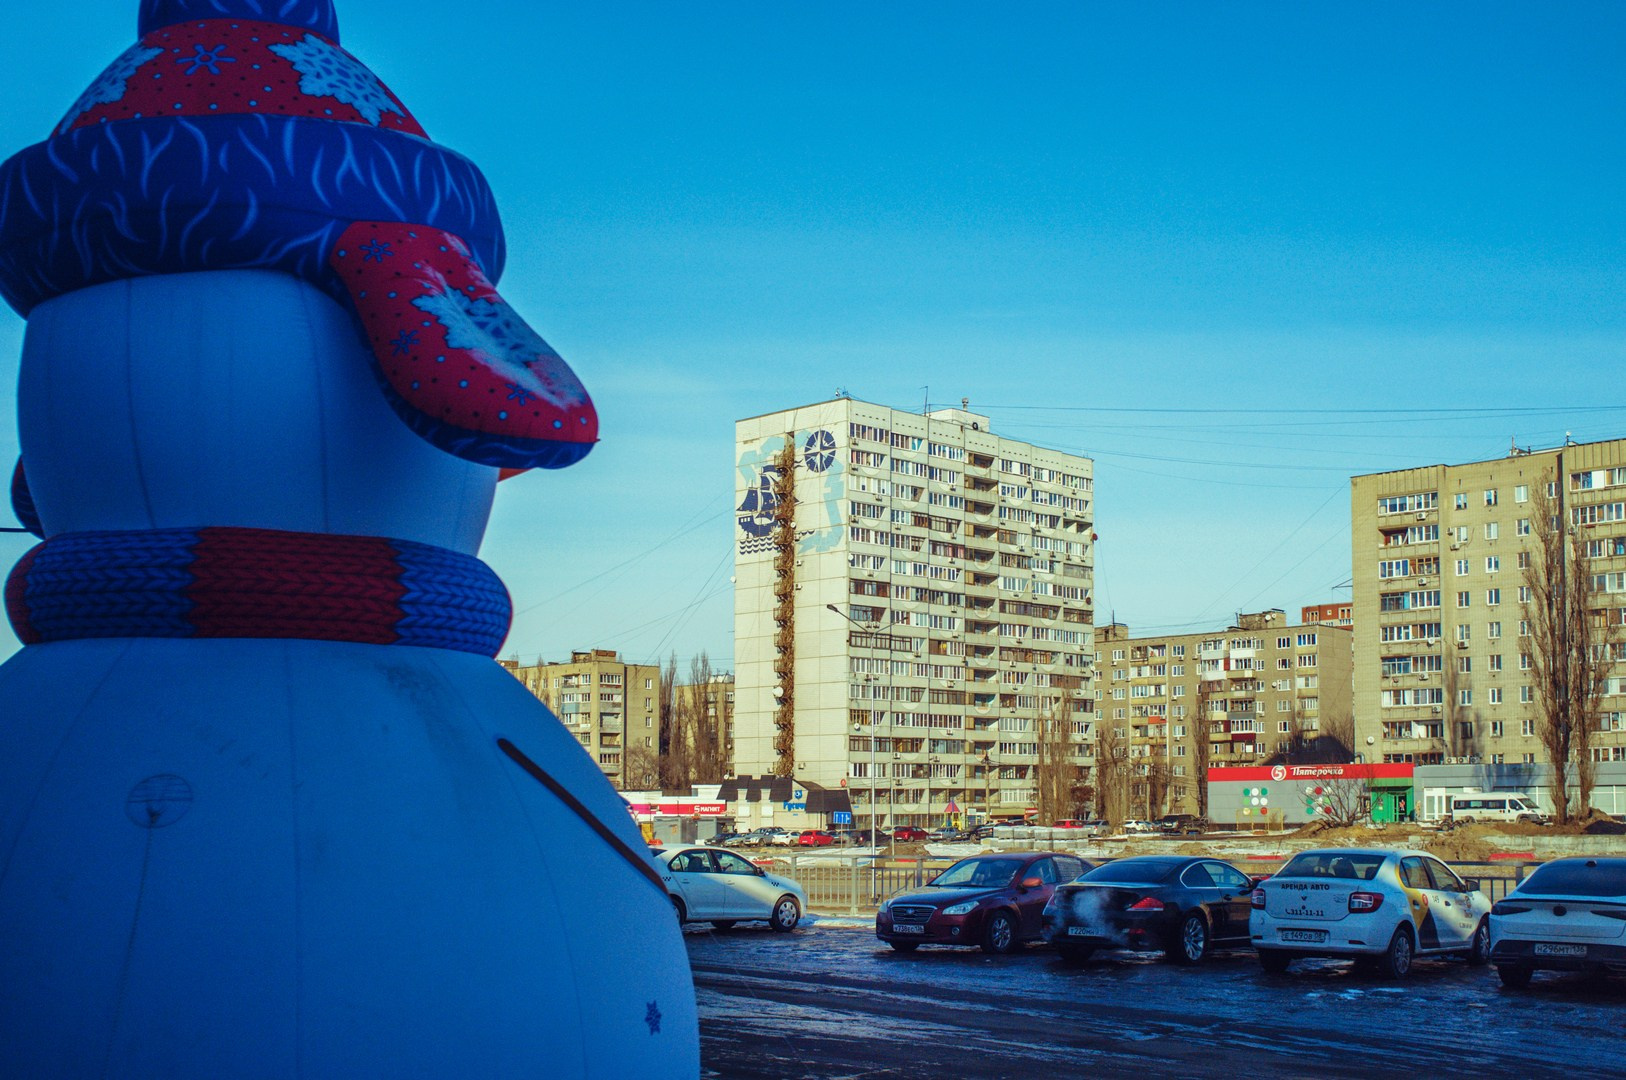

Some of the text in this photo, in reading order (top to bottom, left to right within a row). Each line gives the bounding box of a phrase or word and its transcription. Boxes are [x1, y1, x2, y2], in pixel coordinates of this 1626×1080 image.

[1281, 883, 1330, 891] АРЕНДА АВТО
[1290, 908, 1324, 917] 311-11-11
